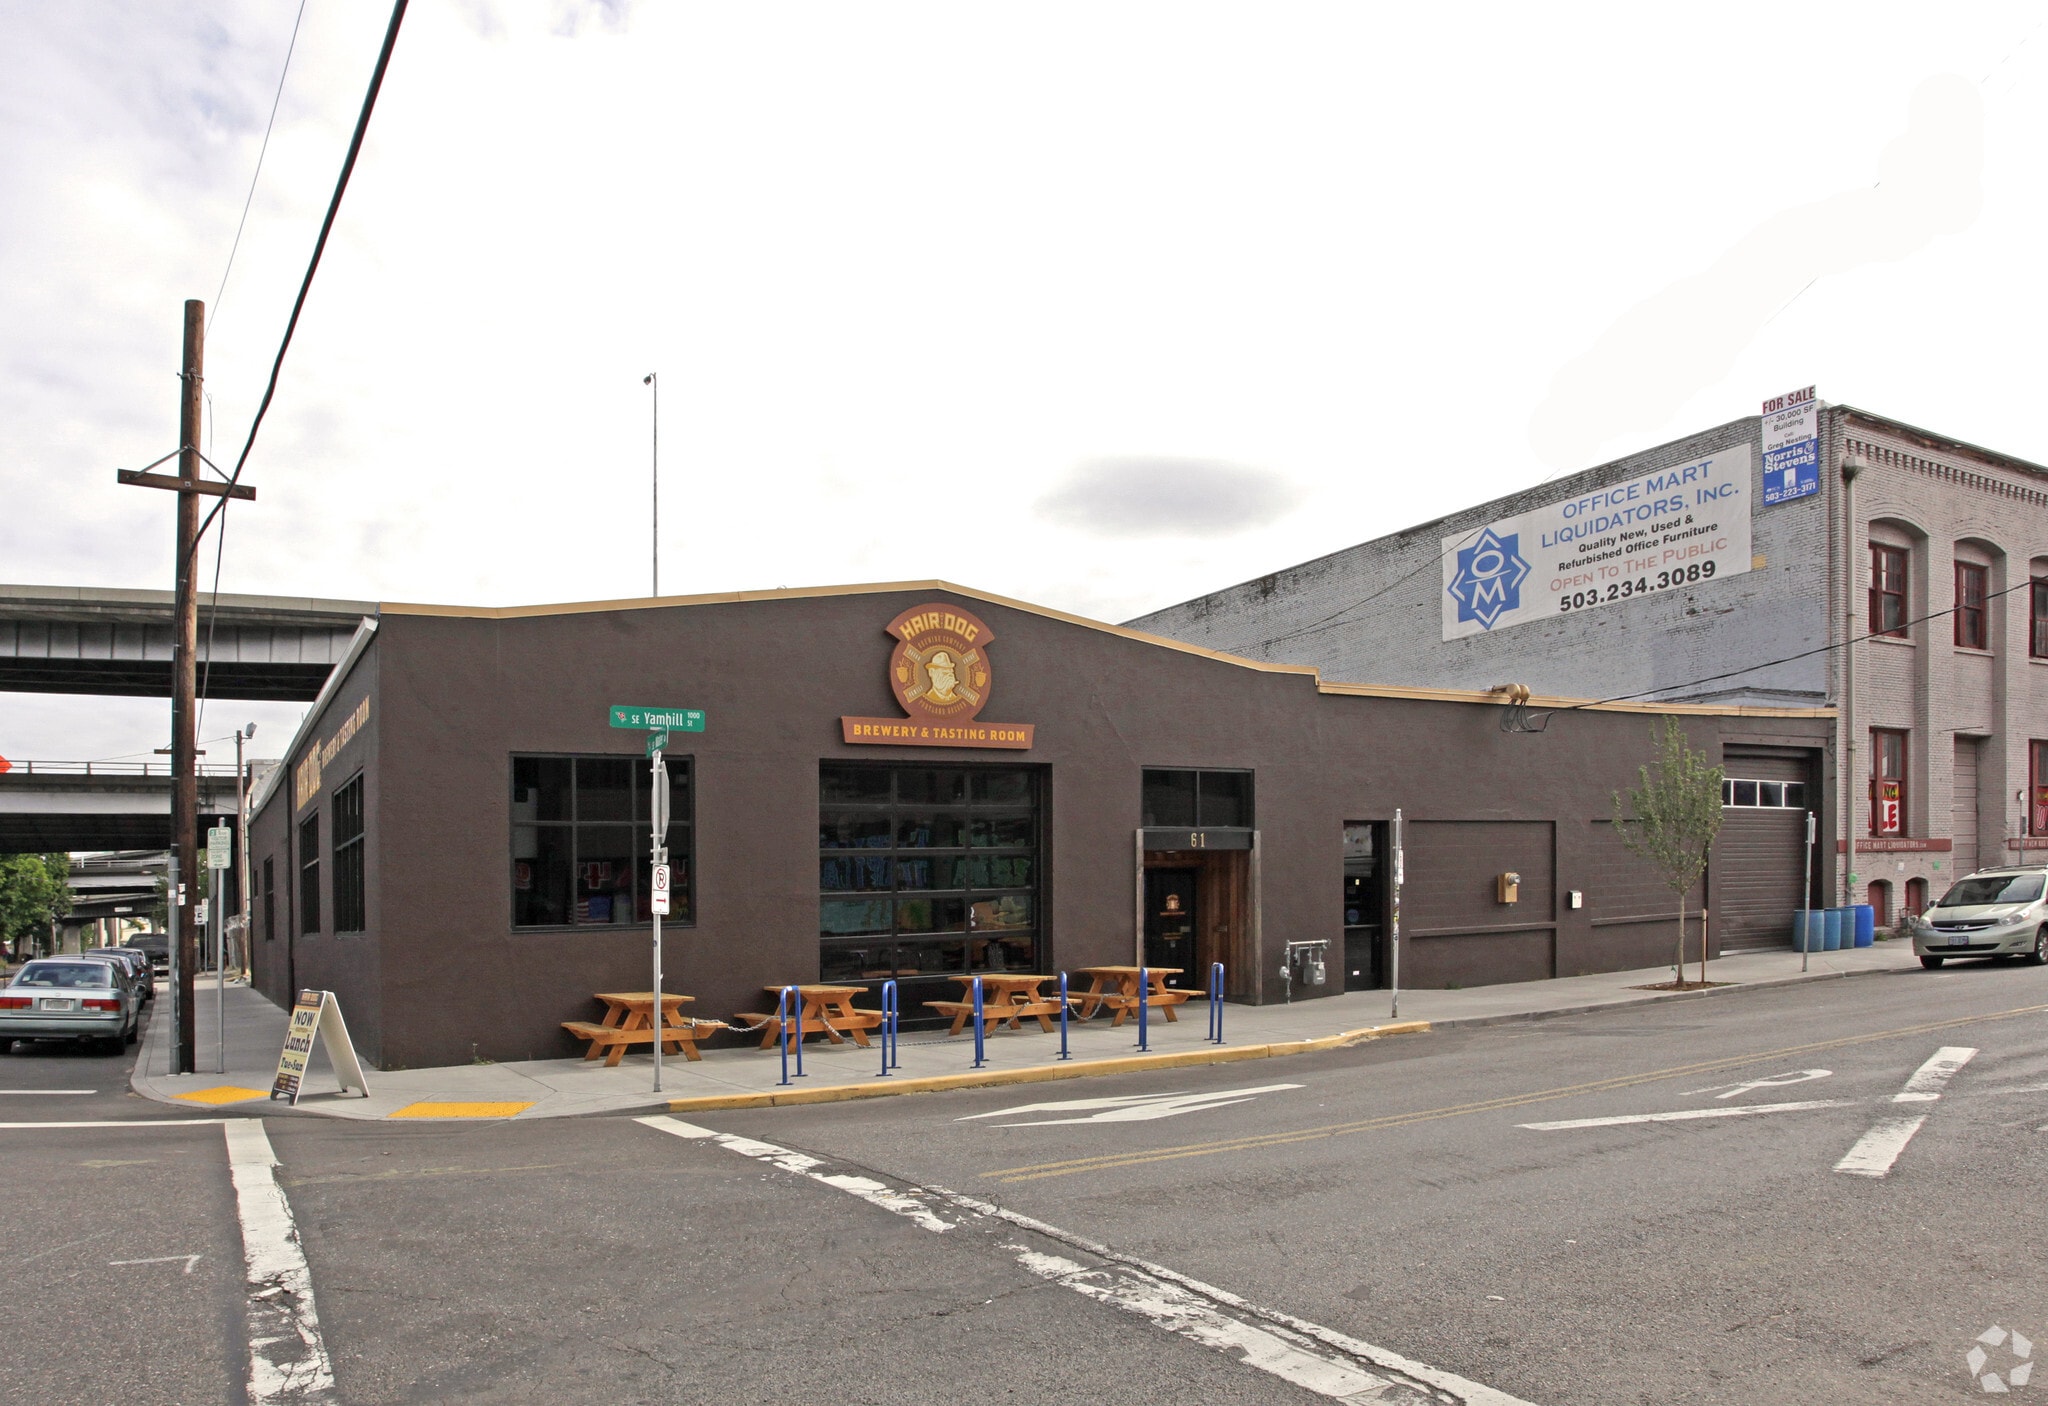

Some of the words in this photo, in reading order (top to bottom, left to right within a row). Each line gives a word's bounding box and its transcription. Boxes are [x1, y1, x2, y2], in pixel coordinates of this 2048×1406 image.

[1762, 397, 1783, 414] FOR
[1788, 386, 1815, 406] SALE
[1804, 404, 1814, 414] SF
[1774, 418, 1804, 431] Building
[1765, 446, 1803, 464] Norris
[1804, 441, 1815, 455] &
[1768, 442, 1784, 451] Greg
[1786, 434, 1812, 445] Nesting
[1765, 453, 1816, 474] Stevens
[1562, 483, 1640, 518] OFFICE
[1646, 460, 1713, 495] MART
[1541, 494, 1689, 548] LIQUIDATORS,
[1697, 482, 1739, 505] INC.
[1579, 536, 1617, 553] Quality
[1620, 529, 1648, 543] New,
[1651, 518, 1681, 534] Used
[1685, 514, 1694, 524] &
[1558, 546, 1622, 571] Refurbished
[1625, 538, 1659, 554] Office
[1663, 522, 1718, 544] Furniture
[1560, 560, 1716, 612] 503.234.3089
[899, 612, 940, 641] HAIR
[944, 612, 979, 642] DOG
[631, 714, 640, 724] SE
[644, 712, 683, 726] Yamhill
[853, 724, 918, 738] BREWERY
[921, 727, 929, 738] &
[933, 727, 986, 740] TASTING
[990, 729, 1026, 742] ROOM
[1191, 832, 1205, 848] 61
[1856, 841, 1871, 849] FFICE
[1873, 841, 1887, 849] MART
[294, 1010, 316, 1026] NOW
[284, 1030, 311, 1053] Lunch
[280, 1057, 303, 1072] Tue-Sun
